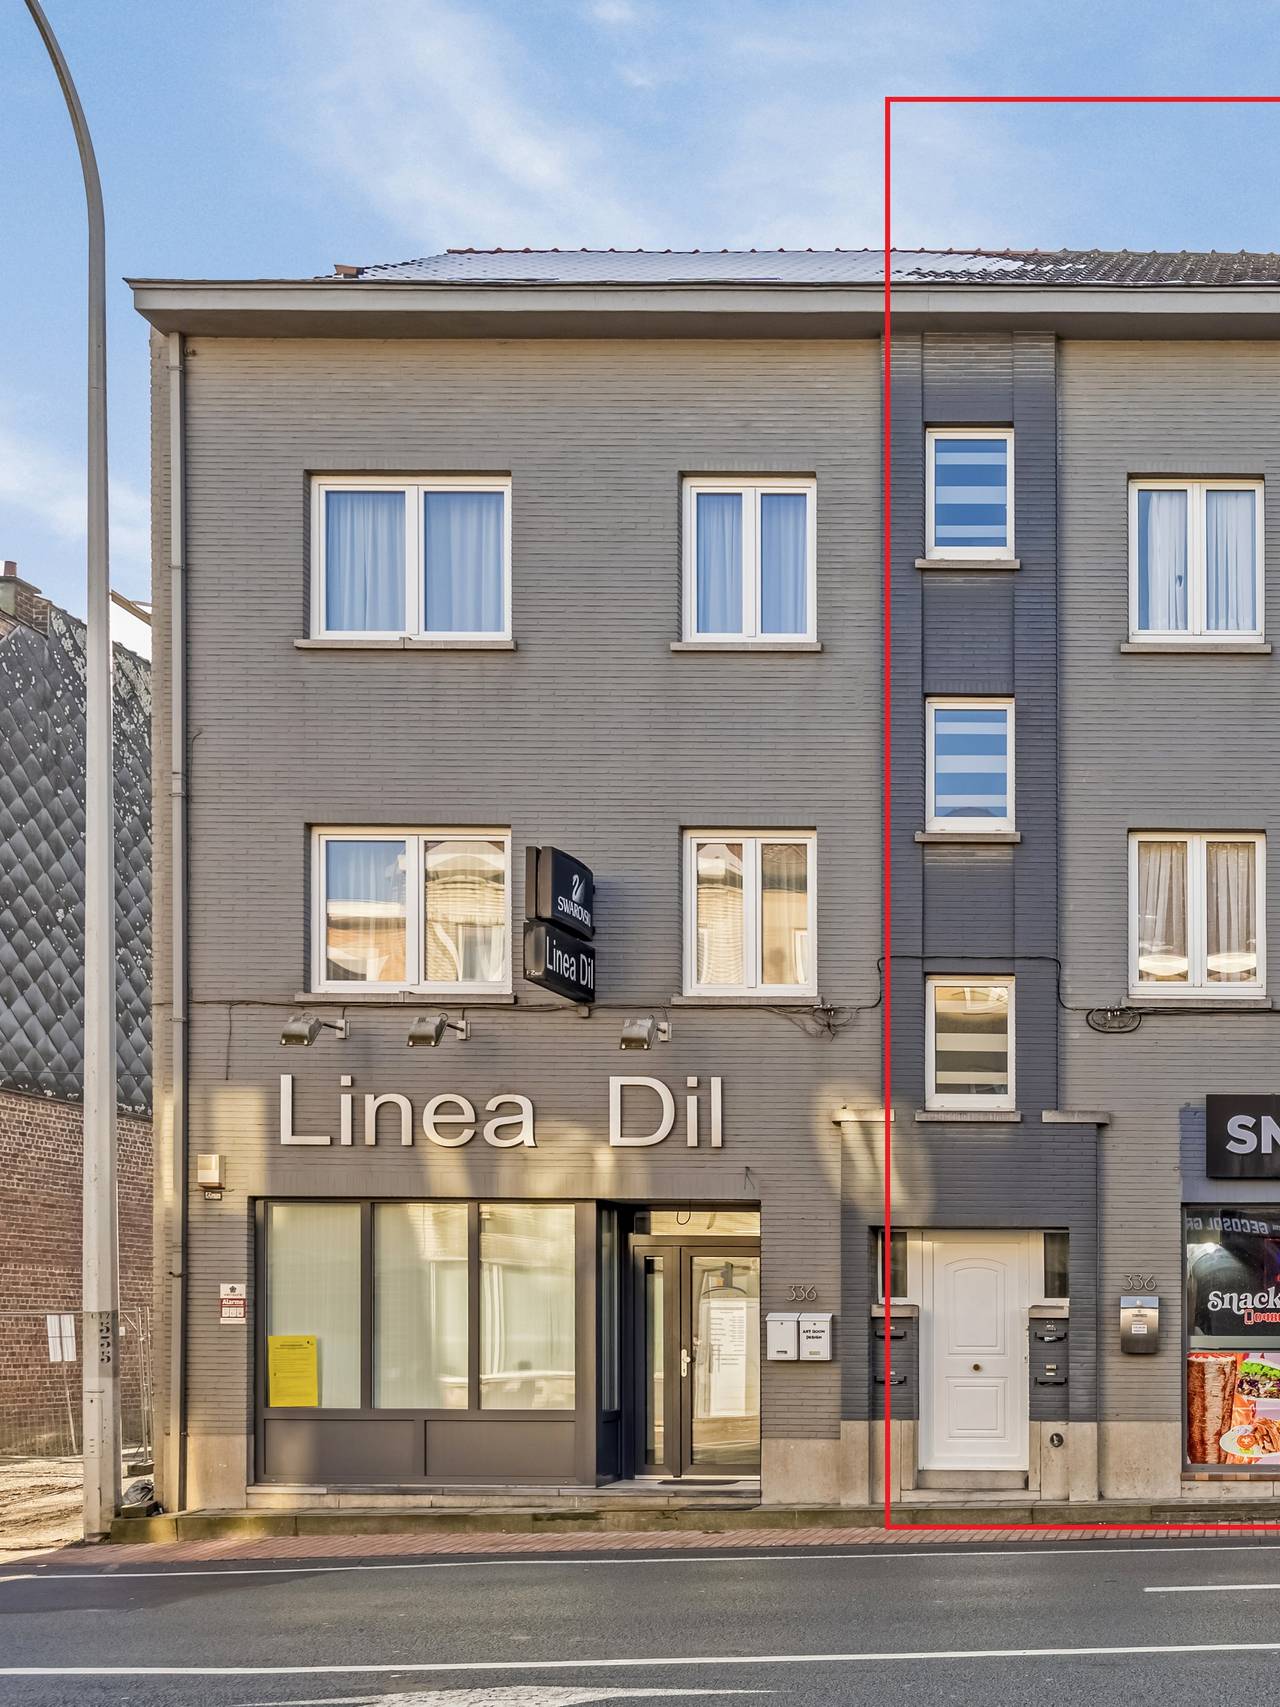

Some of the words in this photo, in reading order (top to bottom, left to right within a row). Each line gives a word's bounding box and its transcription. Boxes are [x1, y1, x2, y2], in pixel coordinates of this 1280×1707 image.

[547, 936, 576, 982] Linea
[580, 953, 594, 990] Dil
[280, 1074, 537, 1148] Linea
[609, 1076, 723, 1148] Dil
[785, 1284, 817, 1301] 336
[1122, 1273, 1156, 1291] 336
